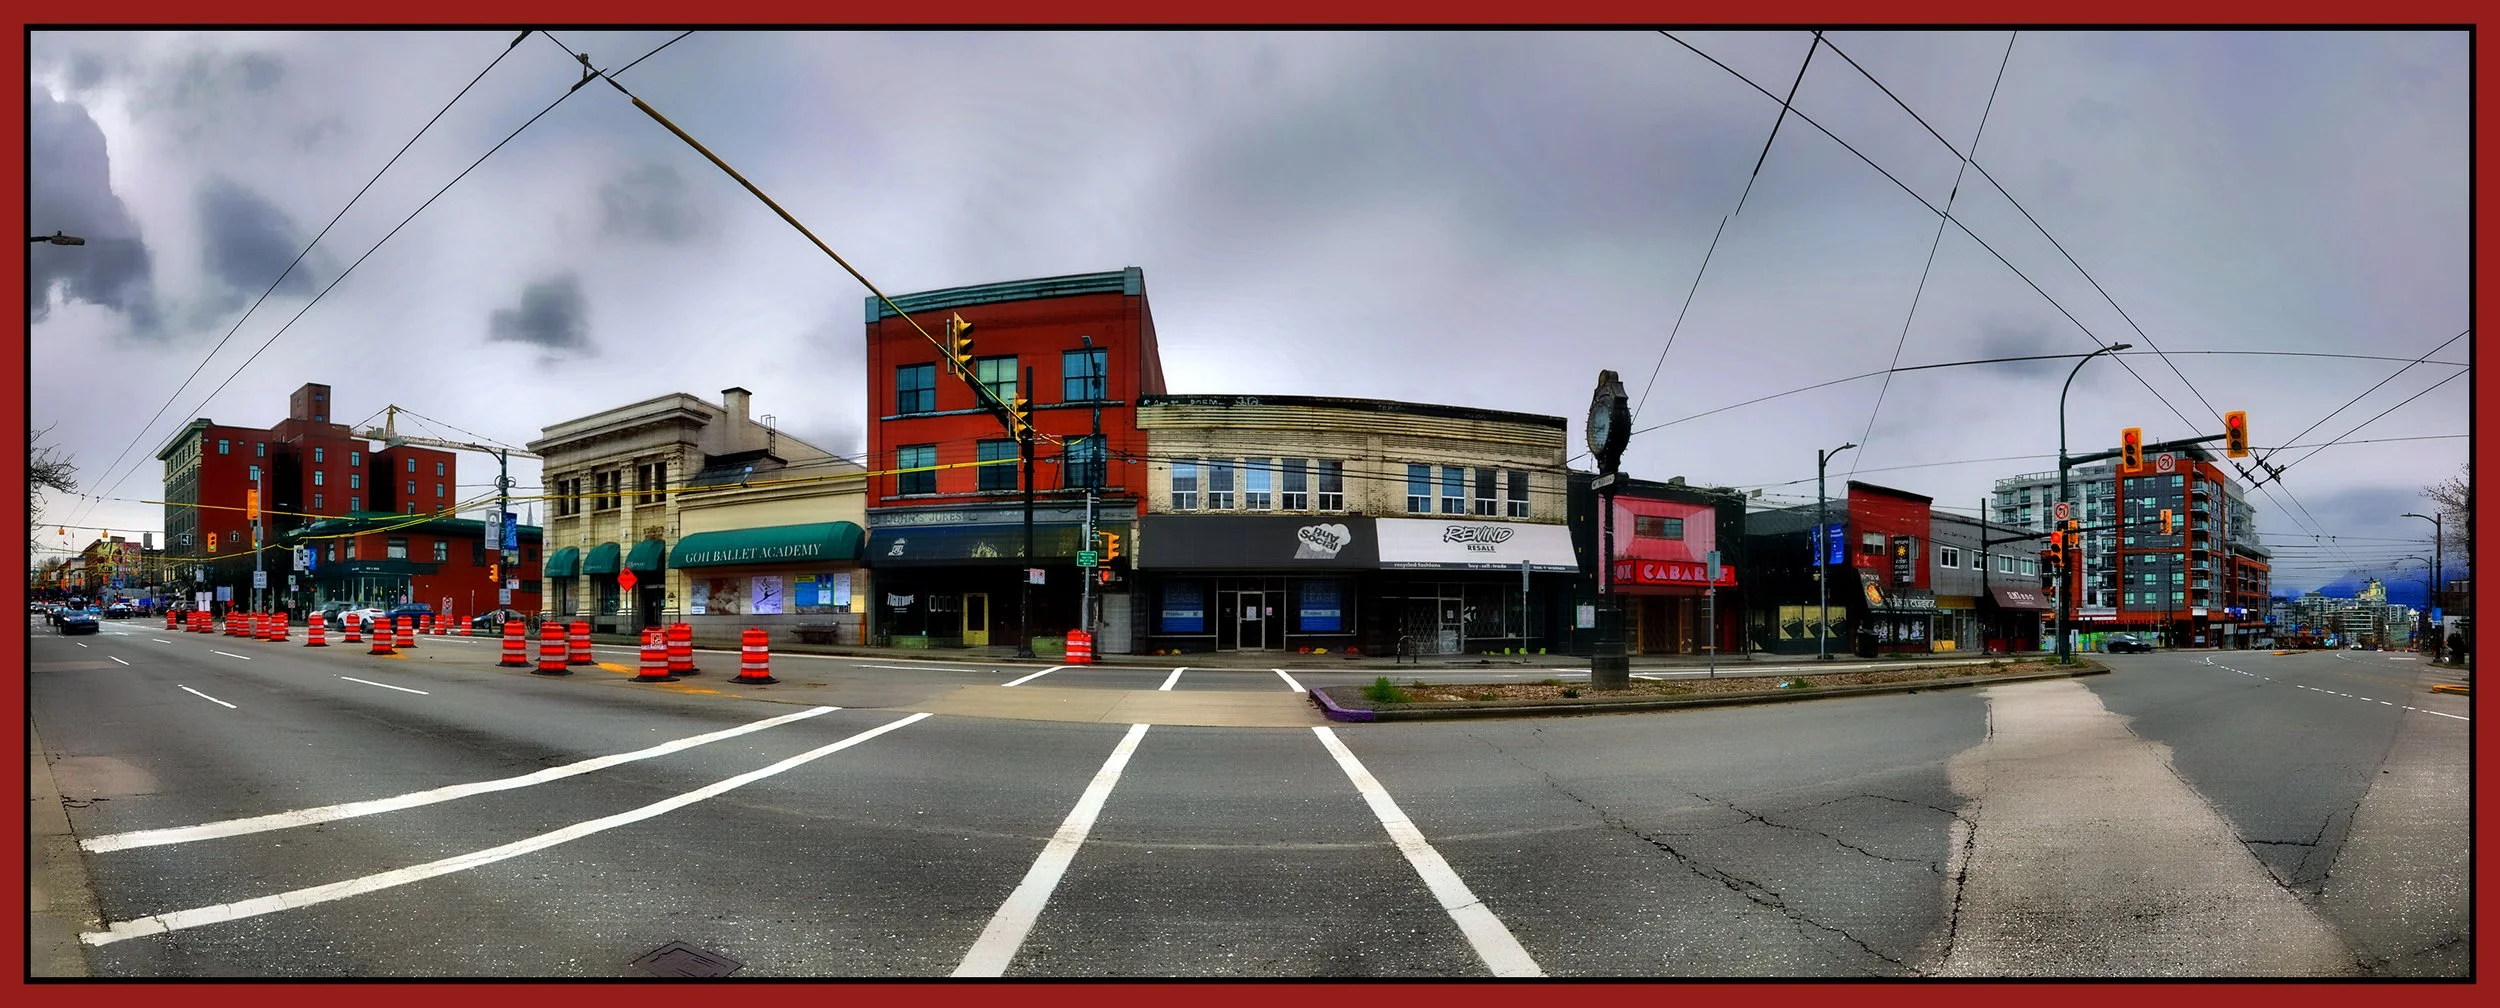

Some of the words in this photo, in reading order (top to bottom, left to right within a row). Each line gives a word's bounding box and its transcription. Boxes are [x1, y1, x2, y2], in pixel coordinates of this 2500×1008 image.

[1299, 529, 1339, 552] Social
[1312, 527, 1341, 543] Anti
[1443, 525, 1514, 544] REWIND
[712, 547, 757, 562] BALLET
[759, 543, 821, 559] ACADEMY
[1467, 544, 1496, 552] RESALE
[1614, 564, 1632, 580] OX
[1643, 563, 1729, 582] CABART
[1303, 592, 1336, 602] LEASE
